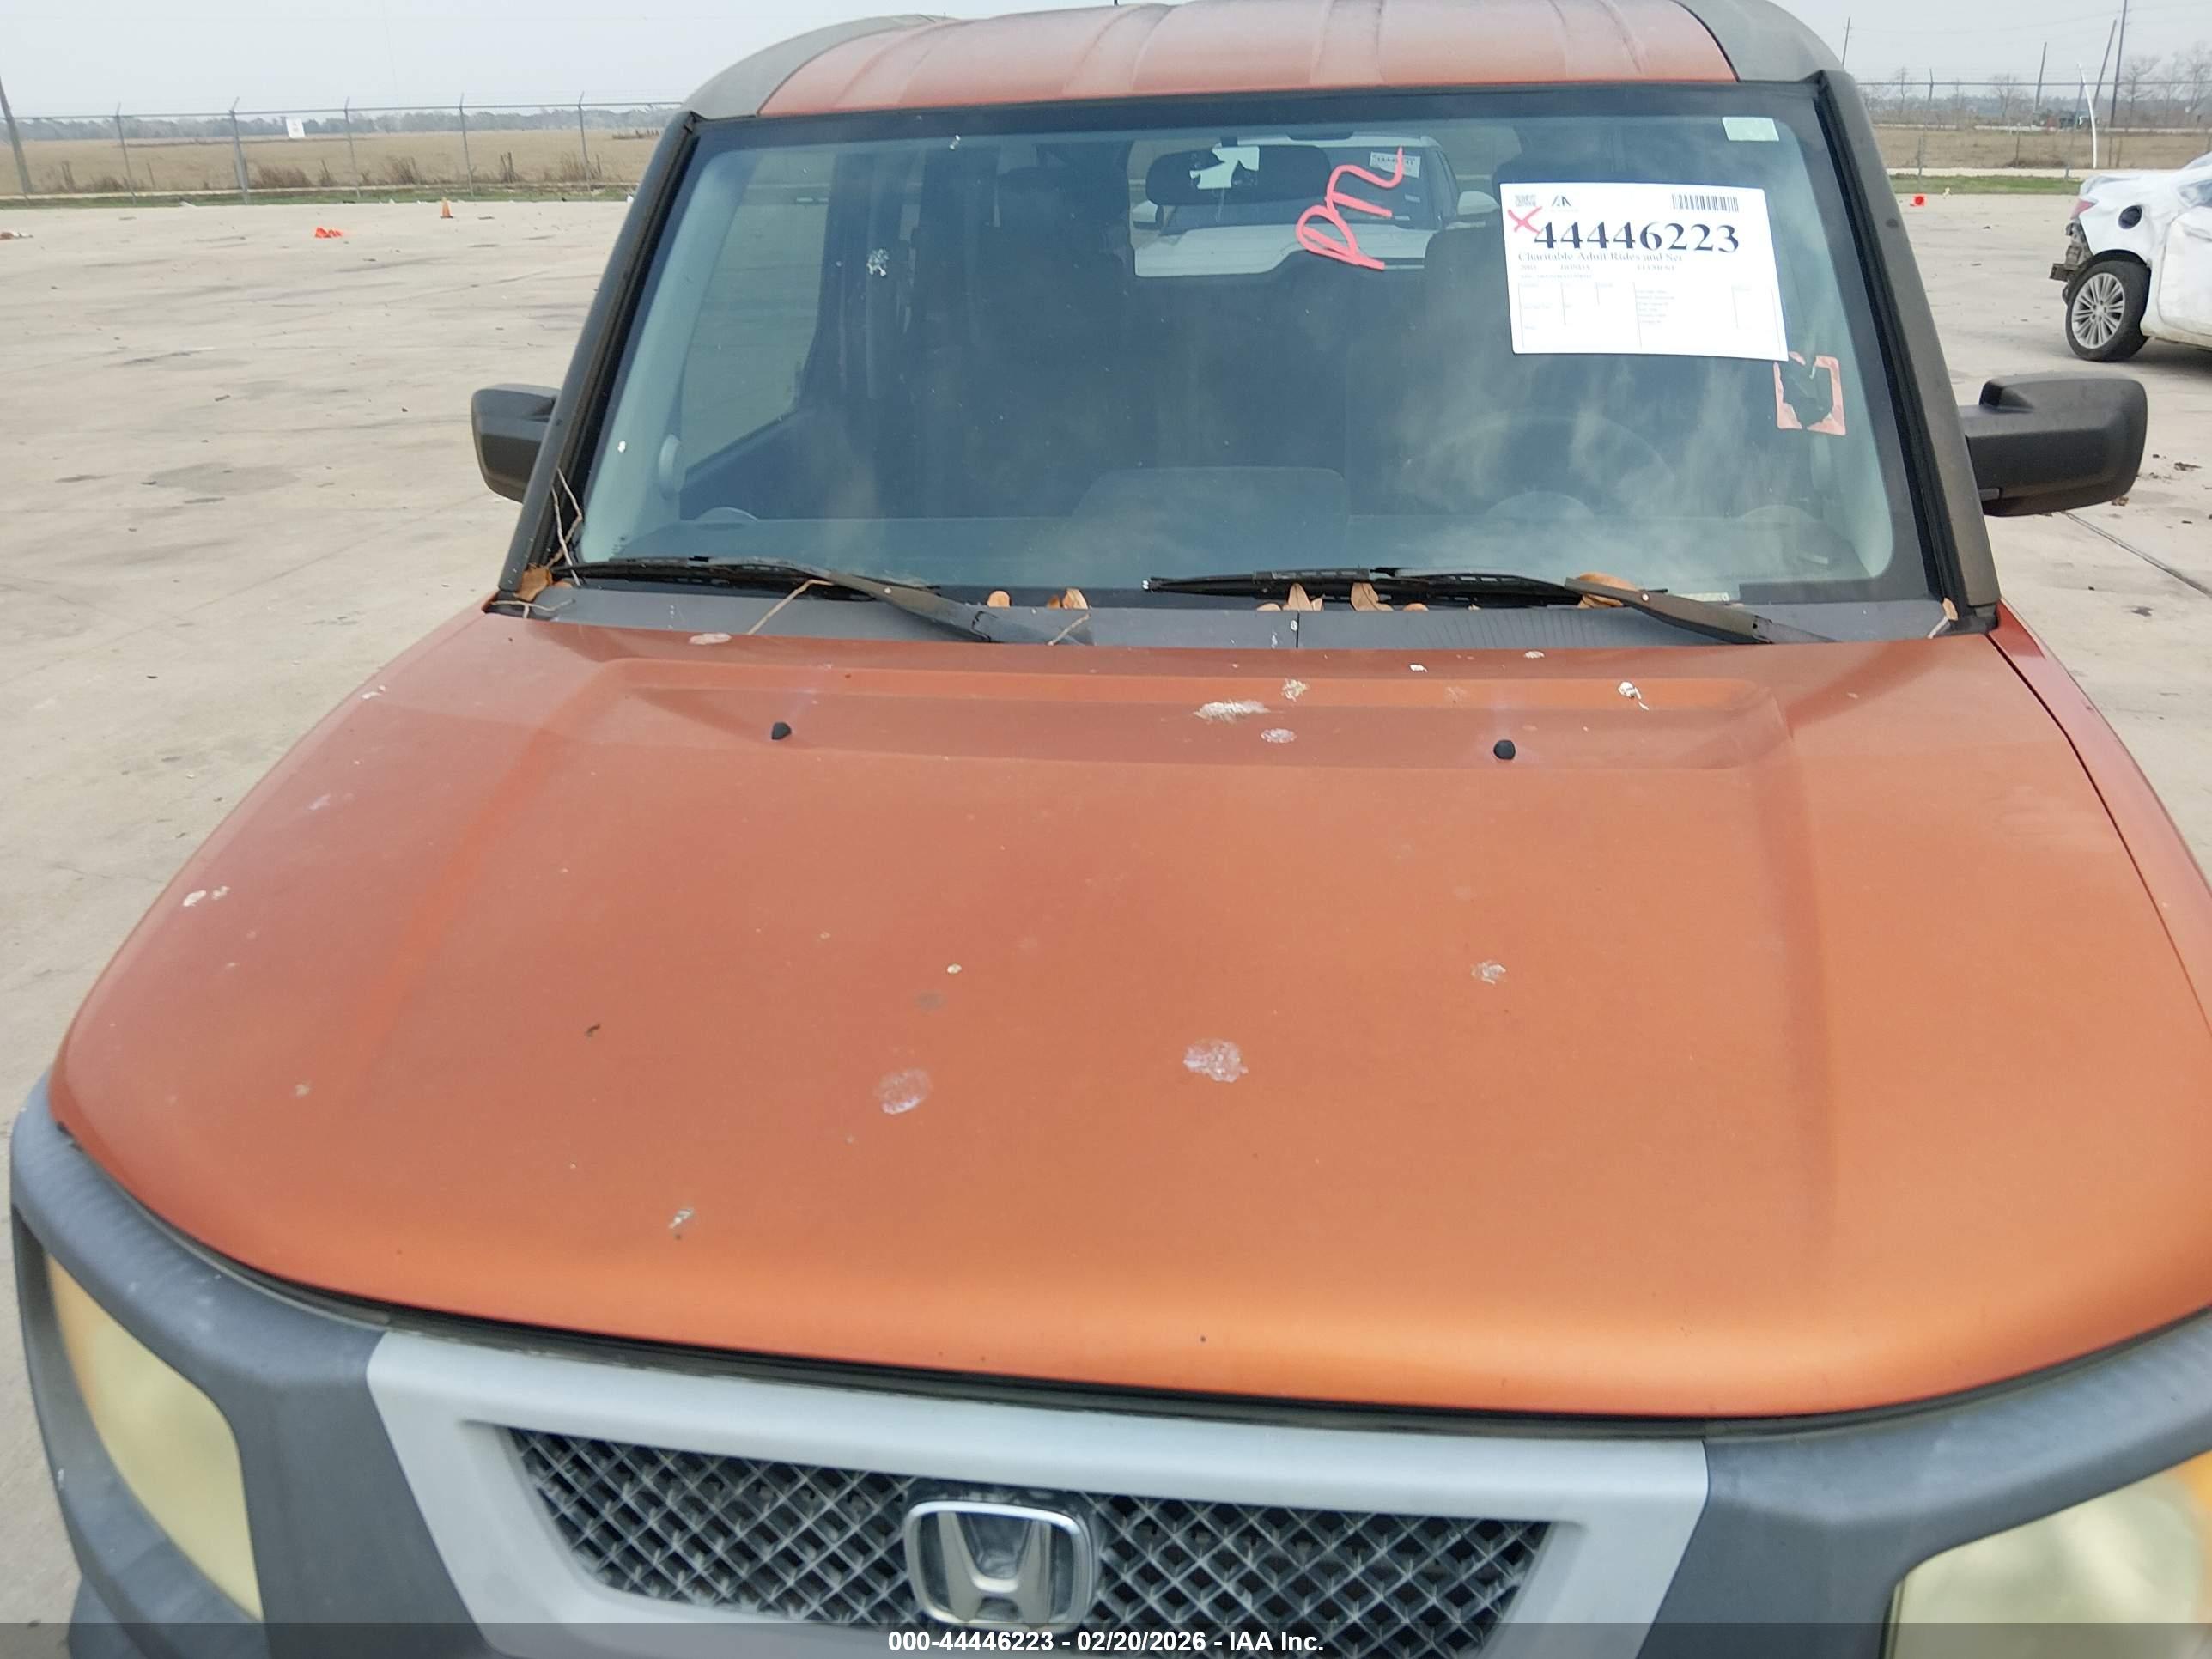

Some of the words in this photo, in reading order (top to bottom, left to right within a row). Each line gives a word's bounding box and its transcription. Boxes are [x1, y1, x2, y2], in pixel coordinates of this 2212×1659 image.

[1534, 220, 1740, 253] 44446223
[1517, 252, 1573, 261] Charitable
[1579, 252, 1606, 261] Adult
[1610, 252, 1640, 261] Rides
[1644, 252, 1662, 262] and
